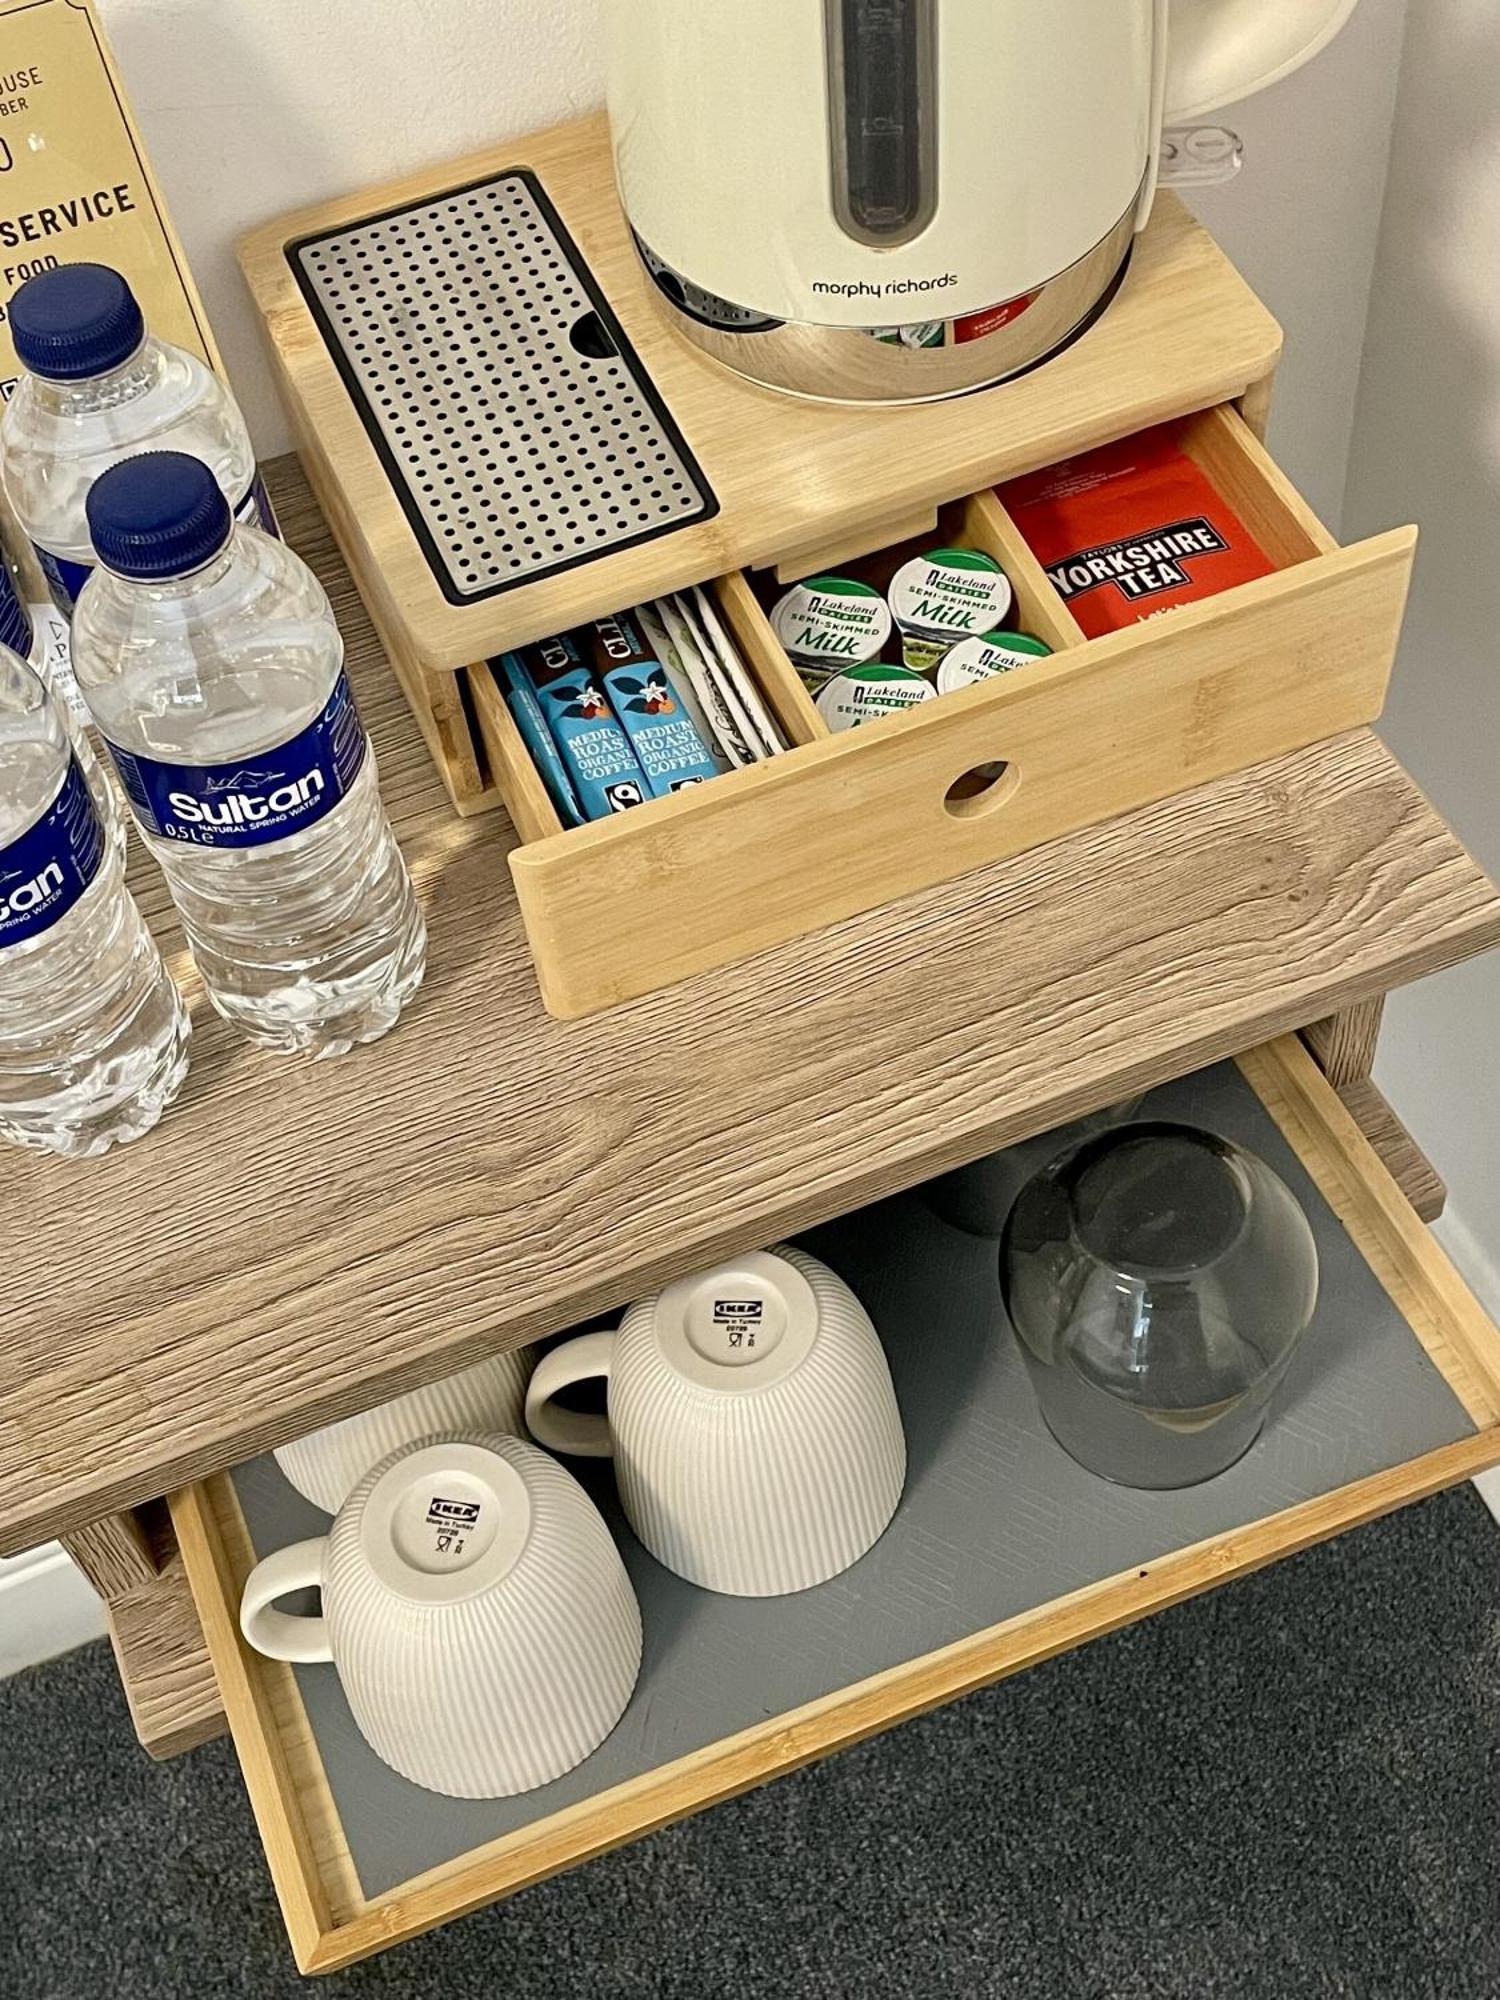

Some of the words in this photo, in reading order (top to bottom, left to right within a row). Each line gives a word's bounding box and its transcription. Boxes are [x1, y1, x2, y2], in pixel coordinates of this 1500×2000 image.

[0, 184, 136, 248] SERVICE
[4, 254, 58, 285] FOOD
[812, 281, 881, 298] morphy
[885, 273, 958, 294] richards
[1048, 527, 1219, 595] YORKSHIRE
[940, 572, 996, 591] Lakeland
[1116, 562, 1183, 594] TEA
[822, 599, 878, 616] Lakeland
[908, 585, 997, 611] SEMI-SKIMMED
[791, 613, 880, 636] SEMI-SKIMMED
[911, 600, 976, 629] Milk
[795, 627, 860, 655] Milk
[992, 653, 1028, 669] Lake
[867, 686, 925, 700] Lakeland
[632, 720, 694, 752] MEDIUM
[639, 731, 698, 764] ROAST
[643, 741, 705, 774] ORGANIC
[647, 752, 709, 776] COFFEE
[169, 768, 325, 825] Sultan
[199, 824, 247, 834] NATURAL
[249, 813, 287, 830] SPRING
[288, 794, 321, 817] WATER
[32, 888, 64, 916] WATER
[717, 1302, 760, 1315] IKEA
[432, 1500, 478, 1519] IKEA
